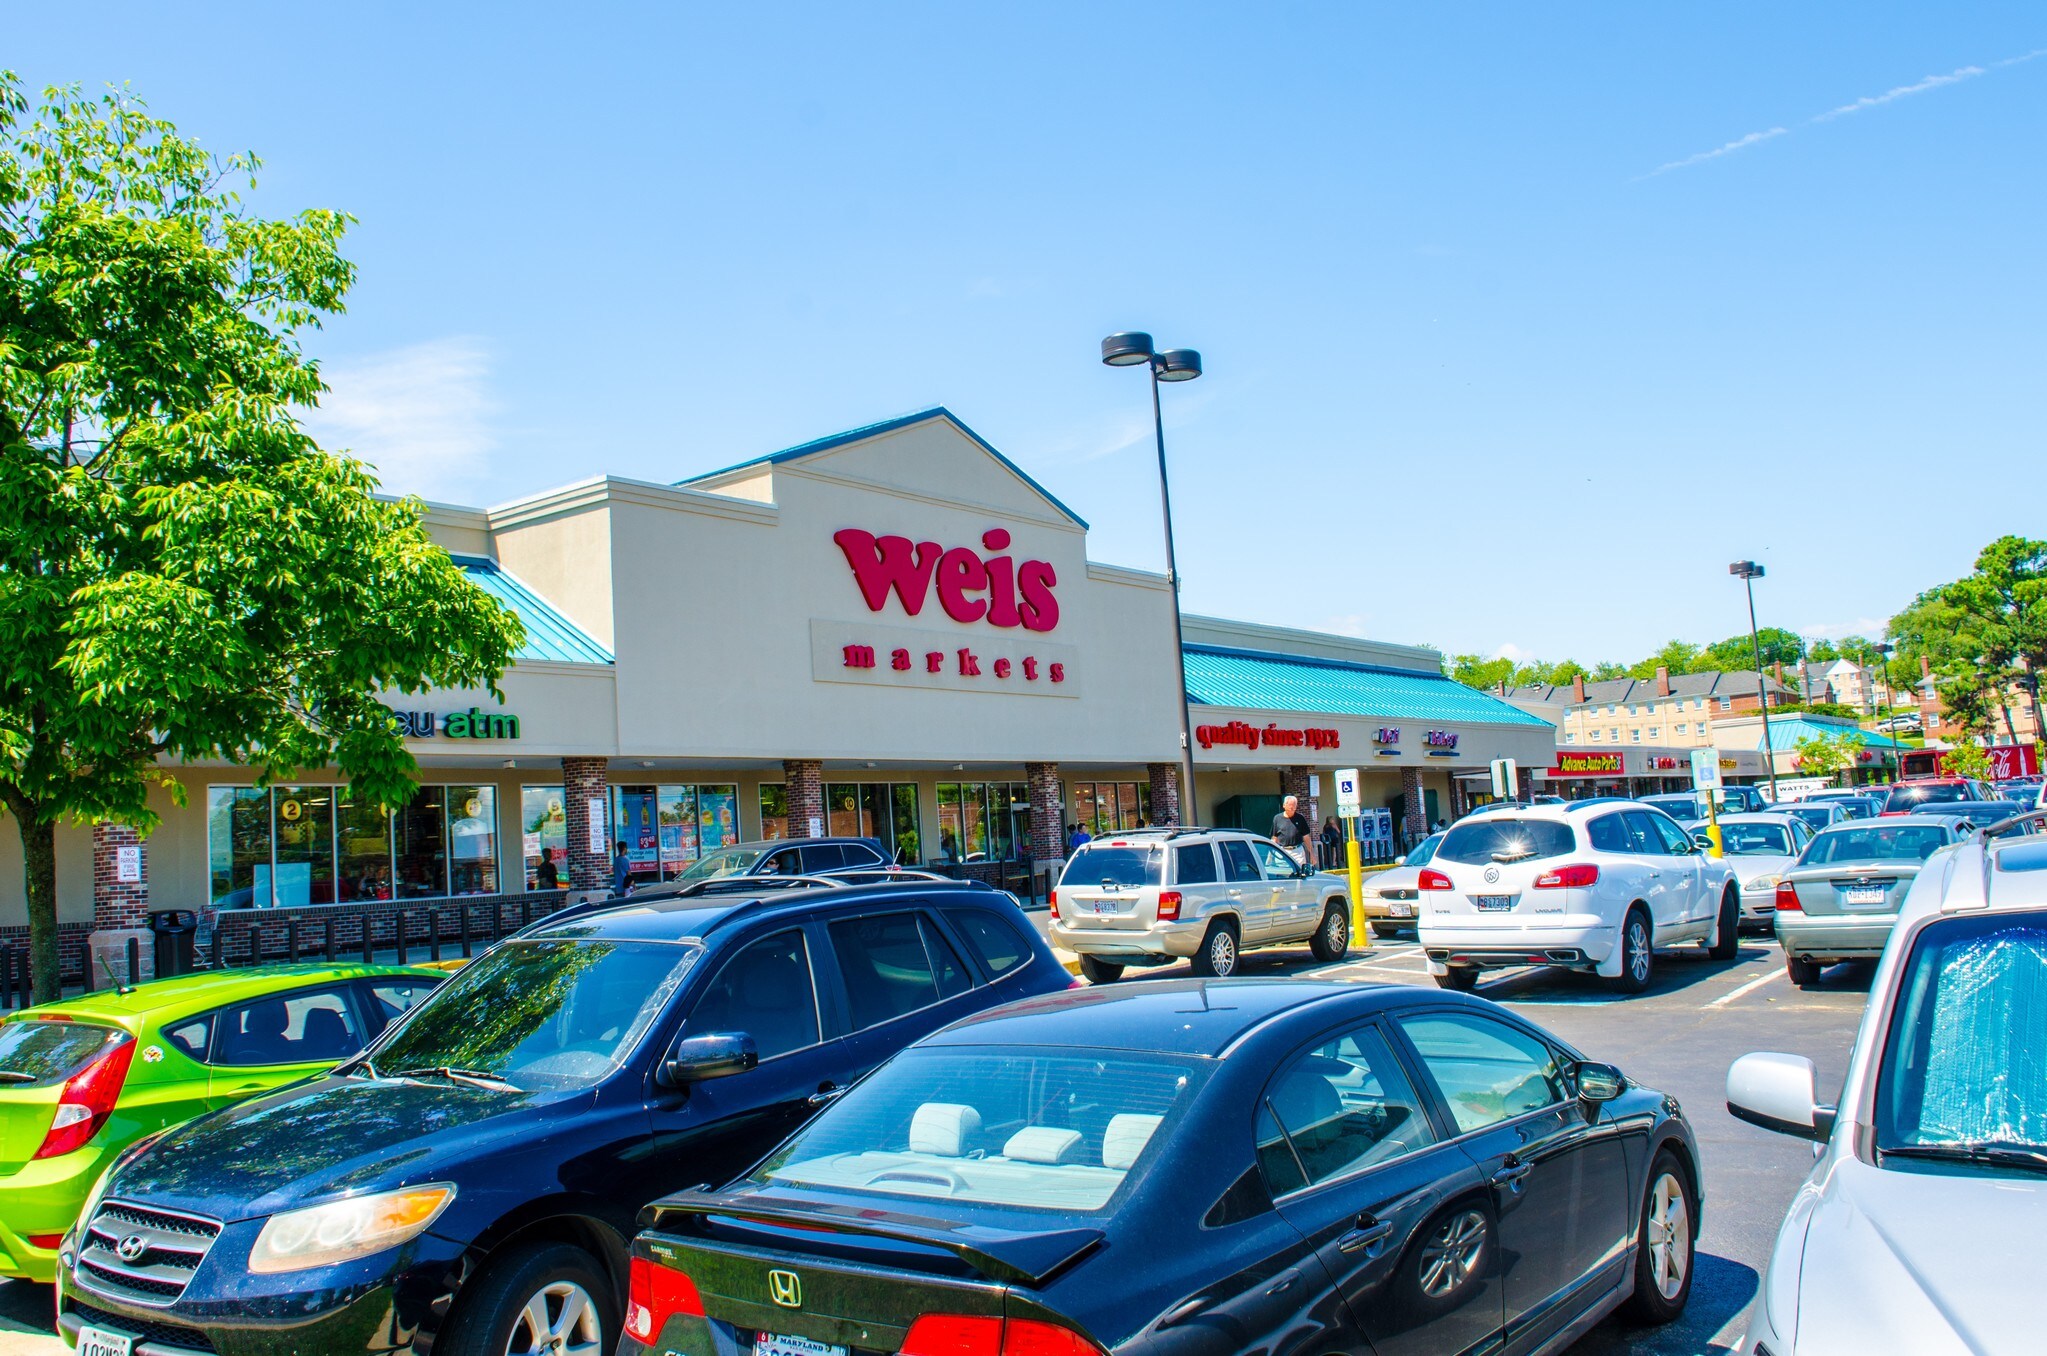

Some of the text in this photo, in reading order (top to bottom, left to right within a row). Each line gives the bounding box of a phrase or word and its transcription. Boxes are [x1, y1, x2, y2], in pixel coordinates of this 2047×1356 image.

[843, 644, 1065, 683] markets
[444, 706, 521, 739] atm
[1196, 721, 1340, 750] quality since 1912
[1379, 727, 1400, 744] Deli
[1428, 730, 1459, 749] Bakery
[1561, 755, 1617, 772] Advance Auto Parts
[287, 803, 297, 816] 2
[124, 849, 136, 857] NO
[779, 1337, 824, 1352] MARYLAND
